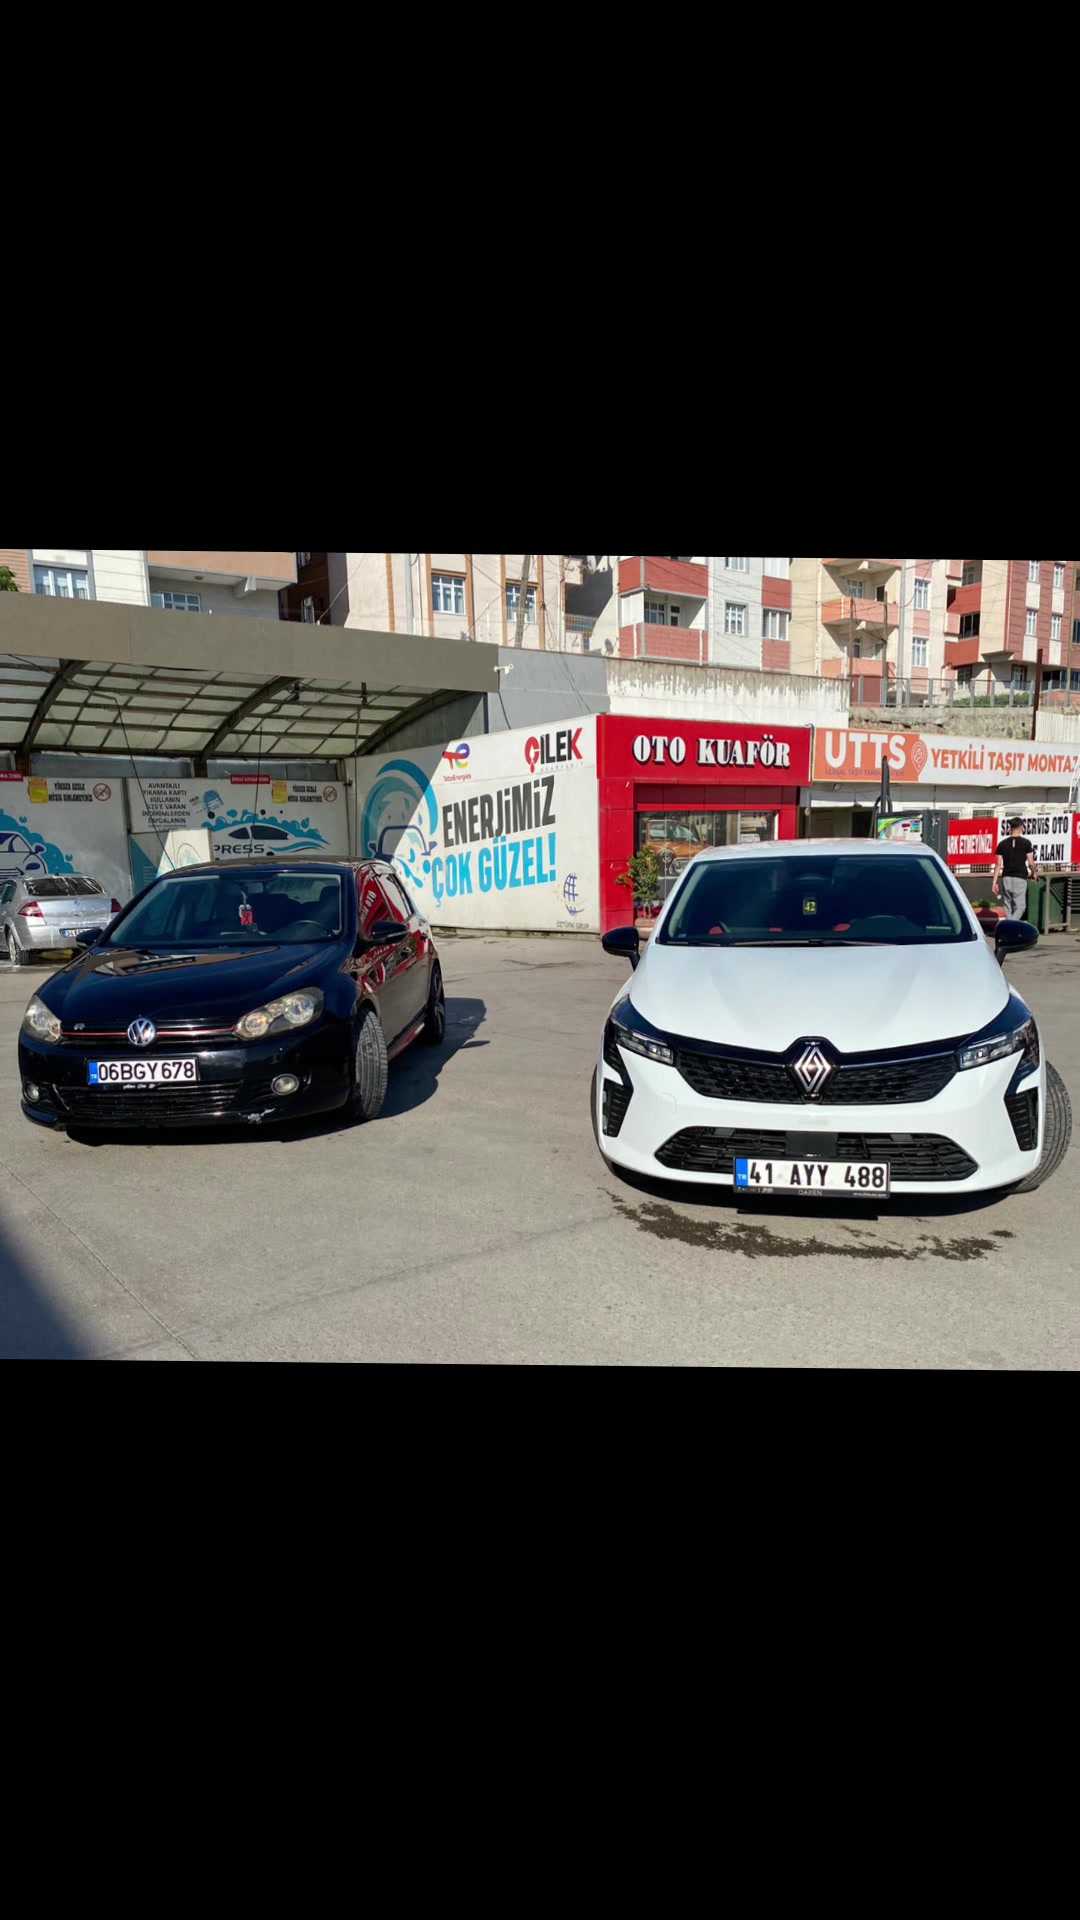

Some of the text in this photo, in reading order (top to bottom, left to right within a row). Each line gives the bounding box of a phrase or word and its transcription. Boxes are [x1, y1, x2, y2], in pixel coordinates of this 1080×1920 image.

[632, 733, 791, 768] OTO KUAFÖR
[825, 731, 906, 770] UTTS
[931, 743, 985, 770] YETKİLİ
[988, 751, 1025, 777] TAŞIT
[443, 773, 472, 782] TotalEnergies
[1052, 816, 1069, 834] OTO
[1040, 844, 1064, 861] ALANI
[431, 832, 557, 908] ÇOK GÜZEL!
[804, 901, 816, 911] 42
[161, 1061, 194, 1080] 678
[750, 1161, 773, 1184] 41
[790, 1163, 829, 1187] AYY
[844, 1165, 885, 1188] 488
